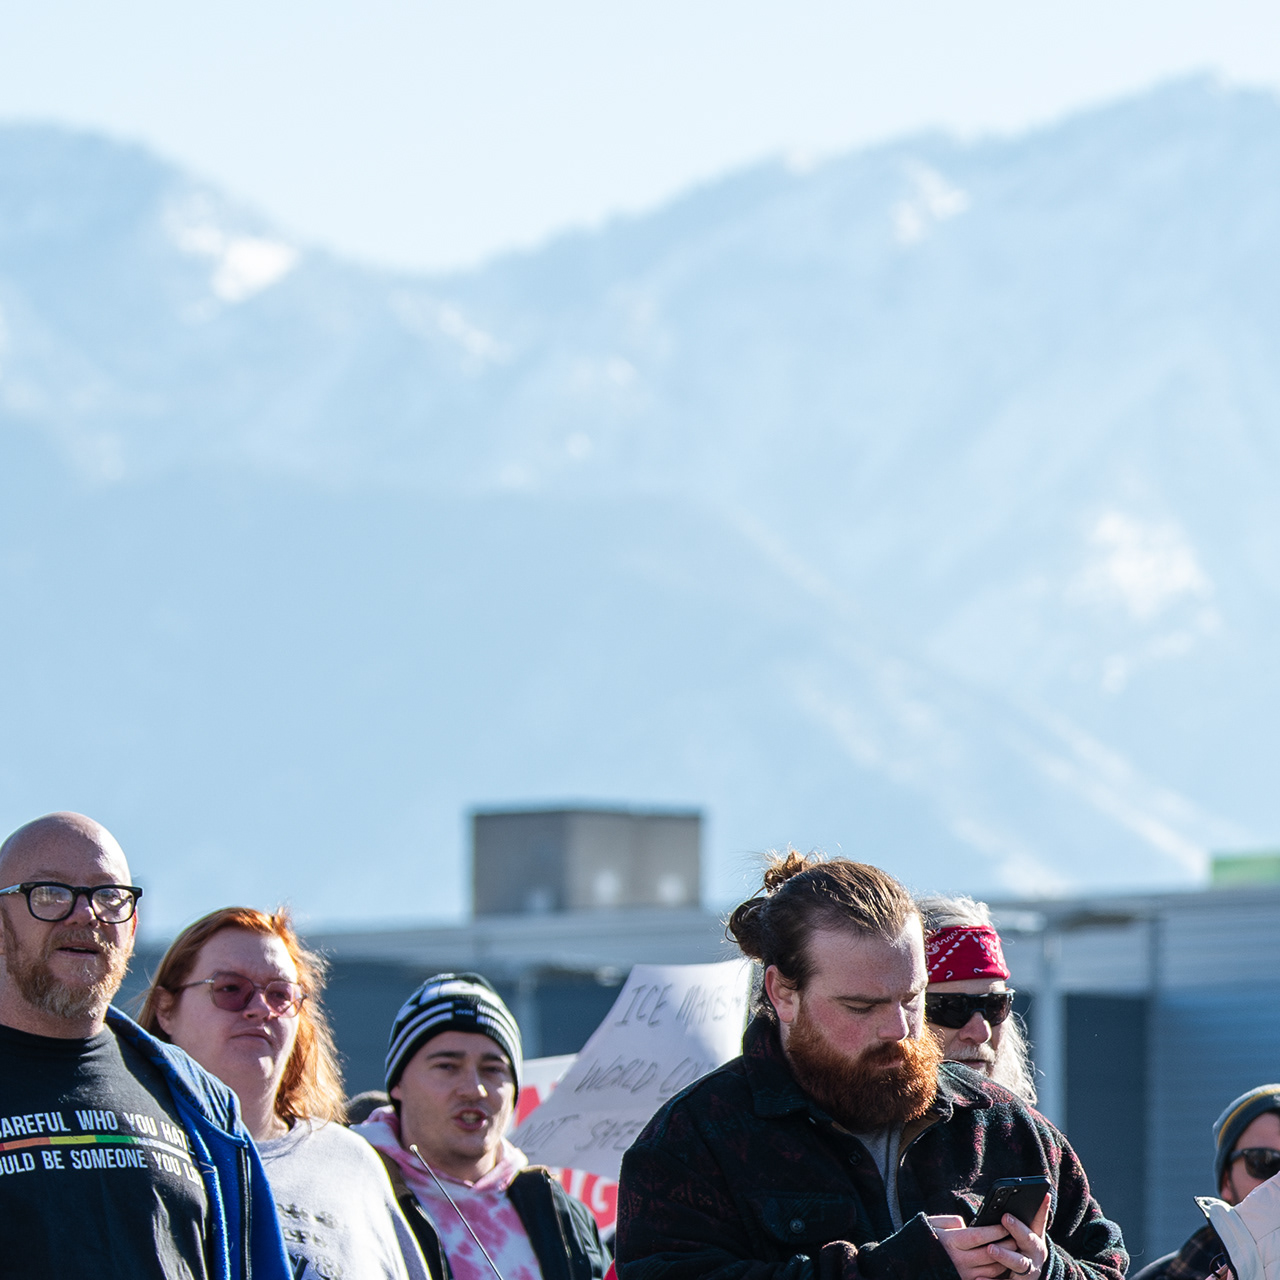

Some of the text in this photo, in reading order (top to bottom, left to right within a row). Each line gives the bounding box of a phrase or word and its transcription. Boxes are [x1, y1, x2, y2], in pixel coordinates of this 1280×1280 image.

[614, 983, 673, 1028] ICE
[575, 1054, 658, 1095] WORLD
[75, 1109, 118, 1131] WHO
[123, 1111, 158, 1137] YOU
[512, 1113, 580, 1150] NOT
[42, 1150, 65, 1170] BE
[71, 1148, 148, 1169] SOMEONE
[151, 1151, 182, 1176] YOU
